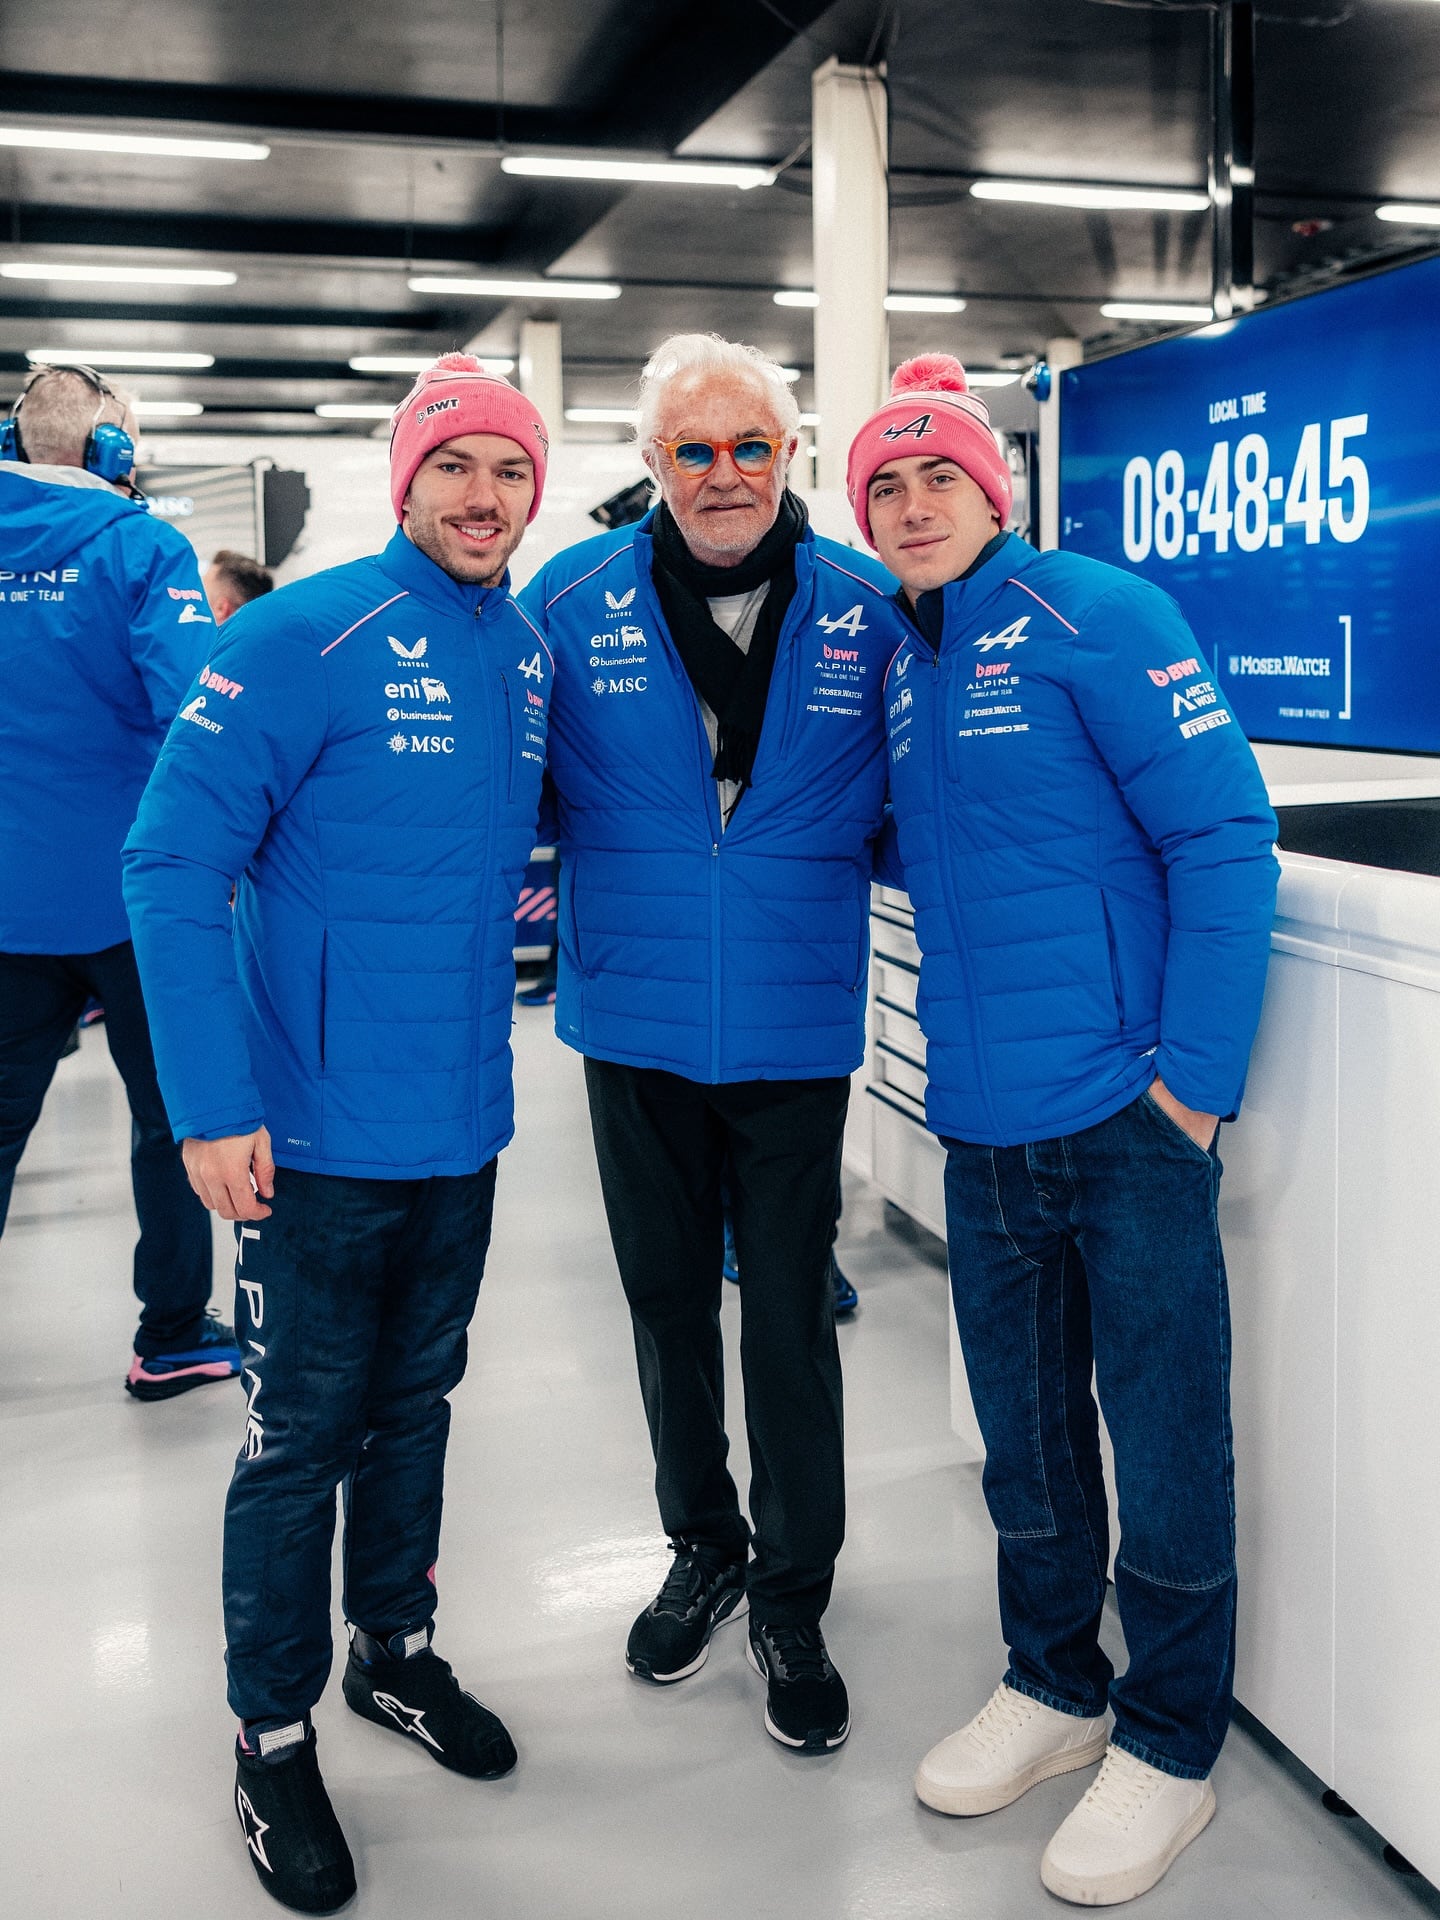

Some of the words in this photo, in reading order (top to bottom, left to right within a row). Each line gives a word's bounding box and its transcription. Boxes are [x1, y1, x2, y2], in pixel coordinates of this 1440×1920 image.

[426, 398, 459, 417] BWT
[1209, 398, 1240, 424] LOCAL
[1241, 391, 1267, 417] TIME
[1123, 413, 1370, 563] 08:48:45
[38, 590, 65, 602] TEAM
[605, 611, 633, 619] CASTORE
[590, 628, 619, 648] eni
[600, 654, 648, 666] businessolver
[833, 648, 859, 662] BWT
[397, 661, 430, 669] CASTORE
[815, 661, 867, 674] ALPINE
[984, 662, 1011, 677] BWT
[1166, 657, 1202, 681] BWT
[206, 672, 244, 700] BWT
[384, 678, 421, 699] eni
[608, 676, 647, 694] MSC
[966, 676, 1020, 691] ALPINE
[1185, 681, 1215, 700] ARCTIC
[889, 694, 901, 720] eni
[1193, 692, 1217, 707] WOLF
[400, 708, 453, 722] businessolver
[1179, 708, 1232, 740] PIRELLI
[410, 735, 455, 754] MSC
[896, 737, 911, 761] MSC
